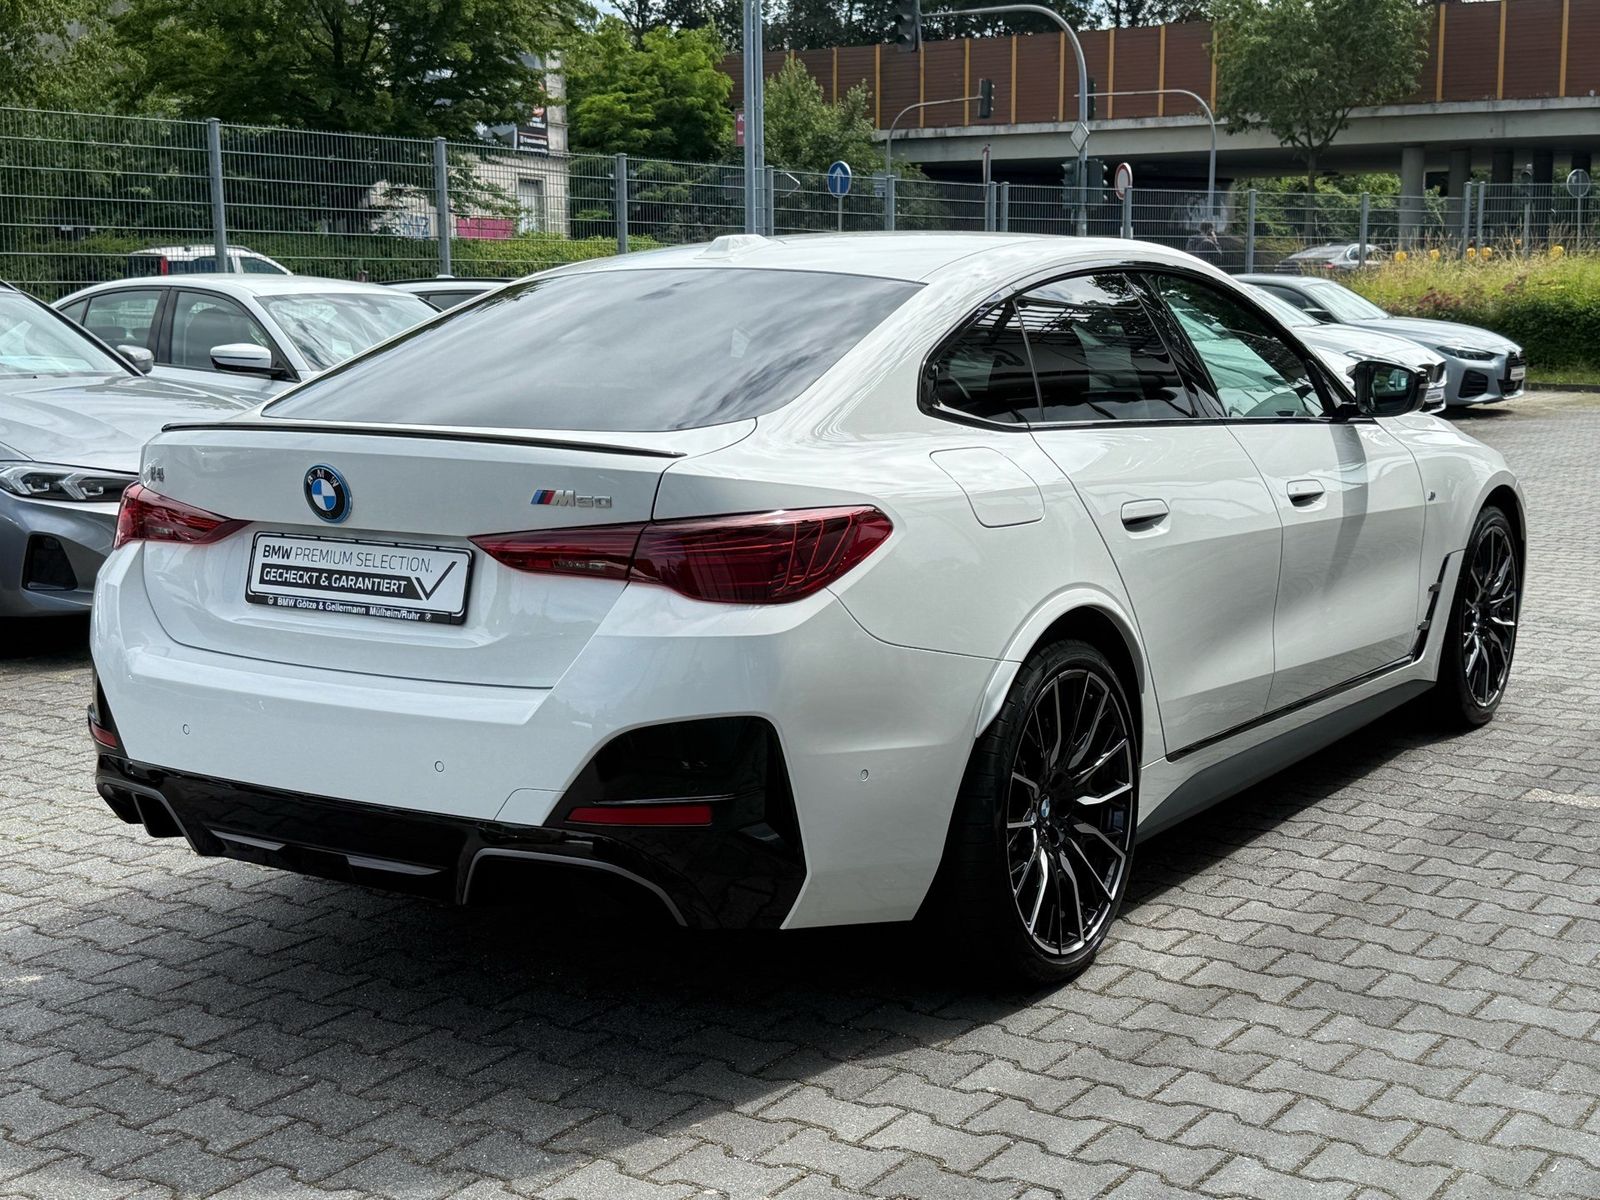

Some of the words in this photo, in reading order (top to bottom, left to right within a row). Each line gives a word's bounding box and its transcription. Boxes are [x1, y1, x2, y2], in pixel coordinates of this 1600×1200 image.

[307, 469, 339, 487] BMW
[550, 489, 612, 508] M50
[262, 544, 293, 560] BMW
[294, 546, 353, 565] PREMIUM
[356, 552, 433, 573] SELECTION.
[263, 568, 319, 585] GECHECKT
[320, 573, 329, 586] &
[331, 574, 408, 593] GARANTIERT
[277, 597, 295, 607] BMW
[318, 602, 324, 610] &
[325, 602, 366, 614] Gellermann
[369, 606, 420, 620] Mülheim/Ruhr
